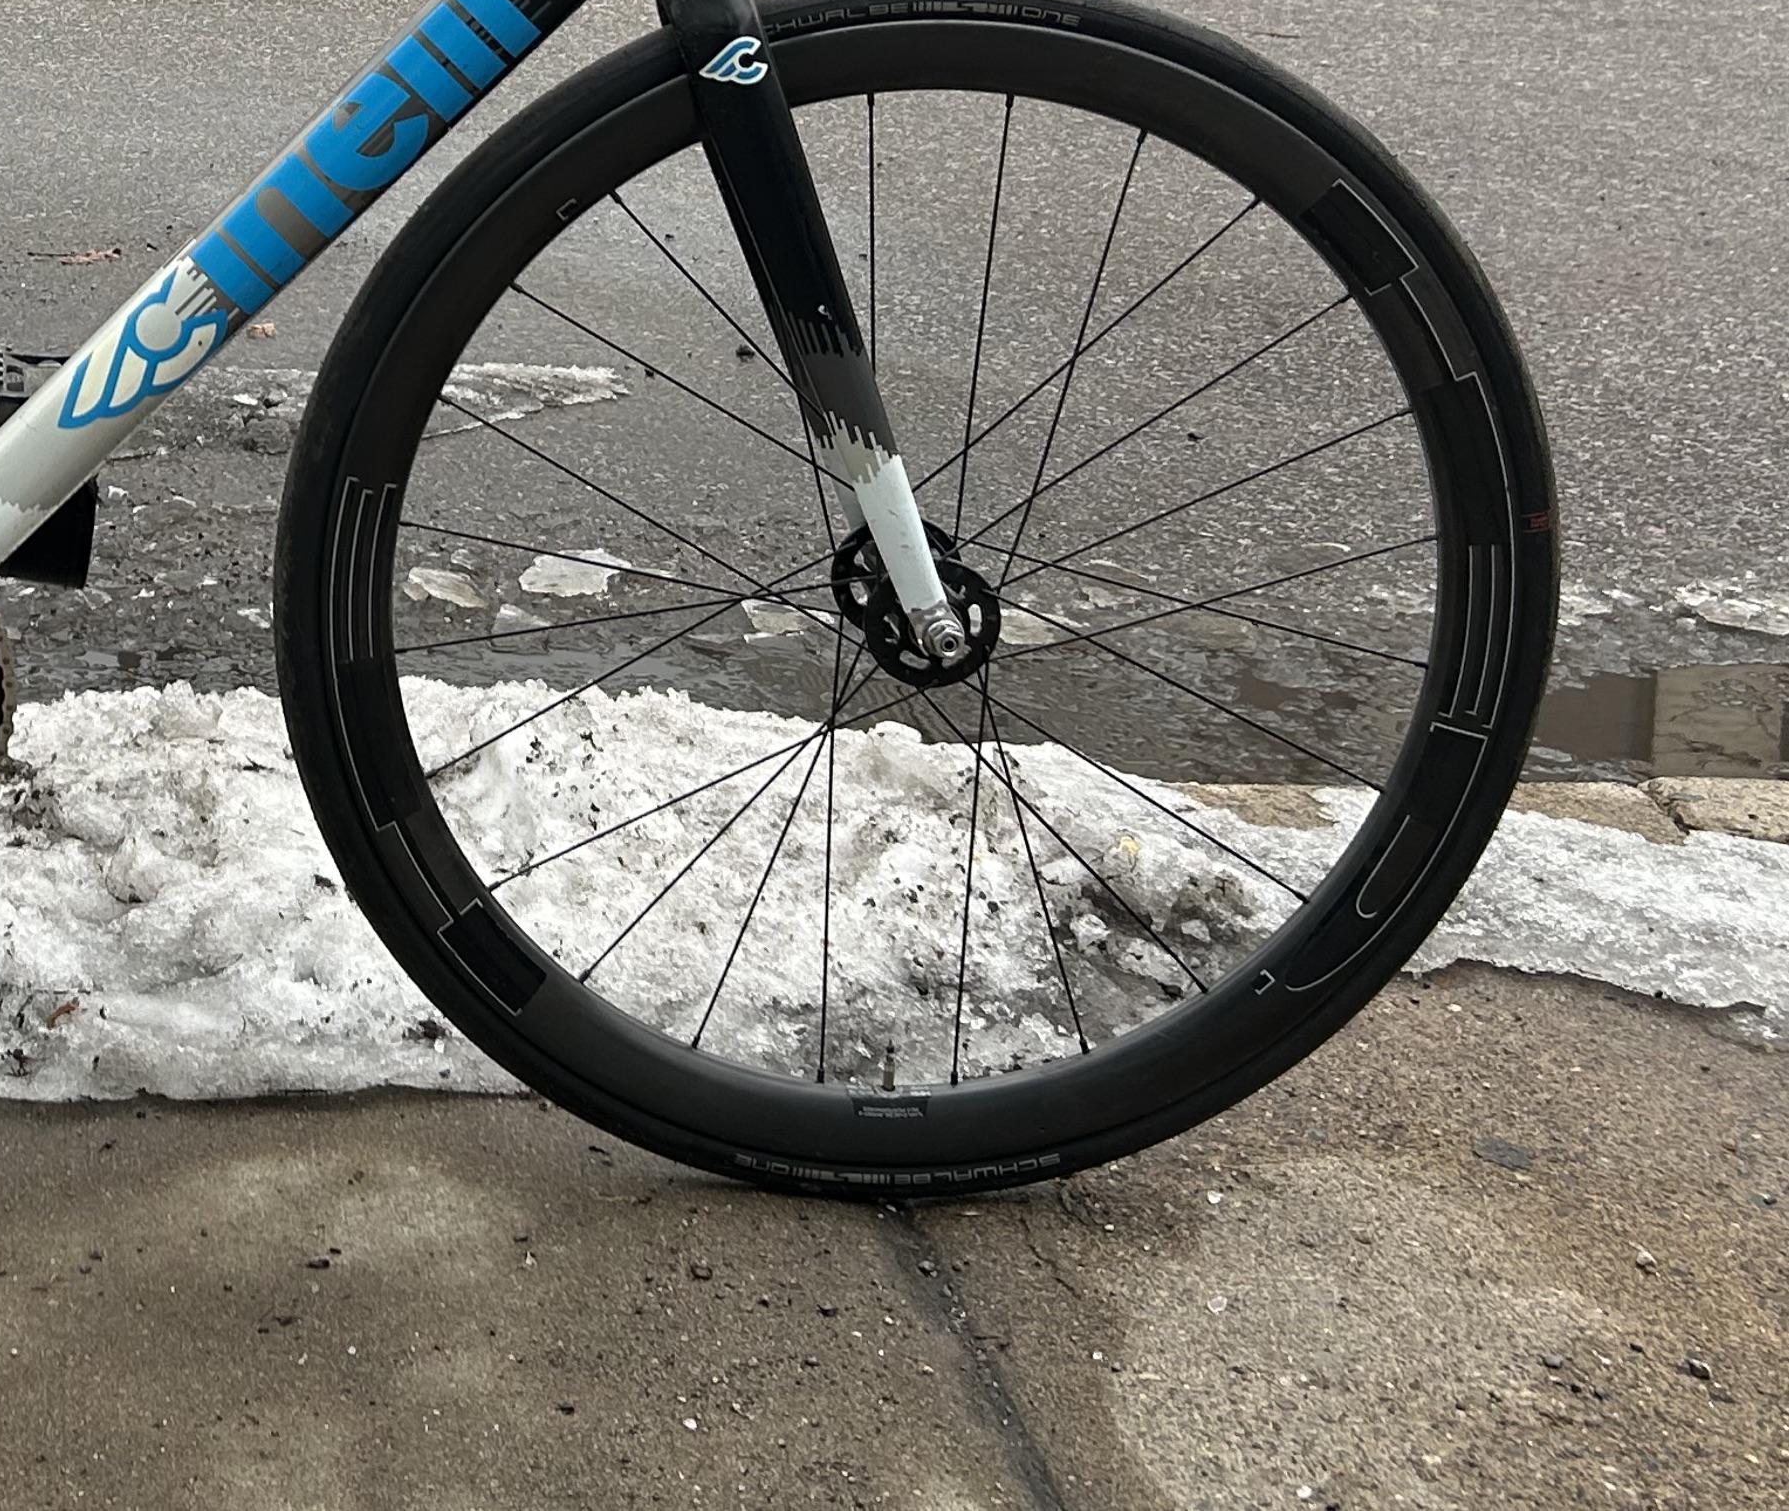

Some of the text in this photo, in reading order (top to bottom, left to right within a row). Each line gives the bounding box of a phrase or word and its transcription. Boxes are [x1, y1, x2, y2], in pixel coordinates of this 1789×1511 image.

[765, 0, 1082, 37] CHWALBE ONE
[893, 1152, 1061, 1186] SCHWALBE
